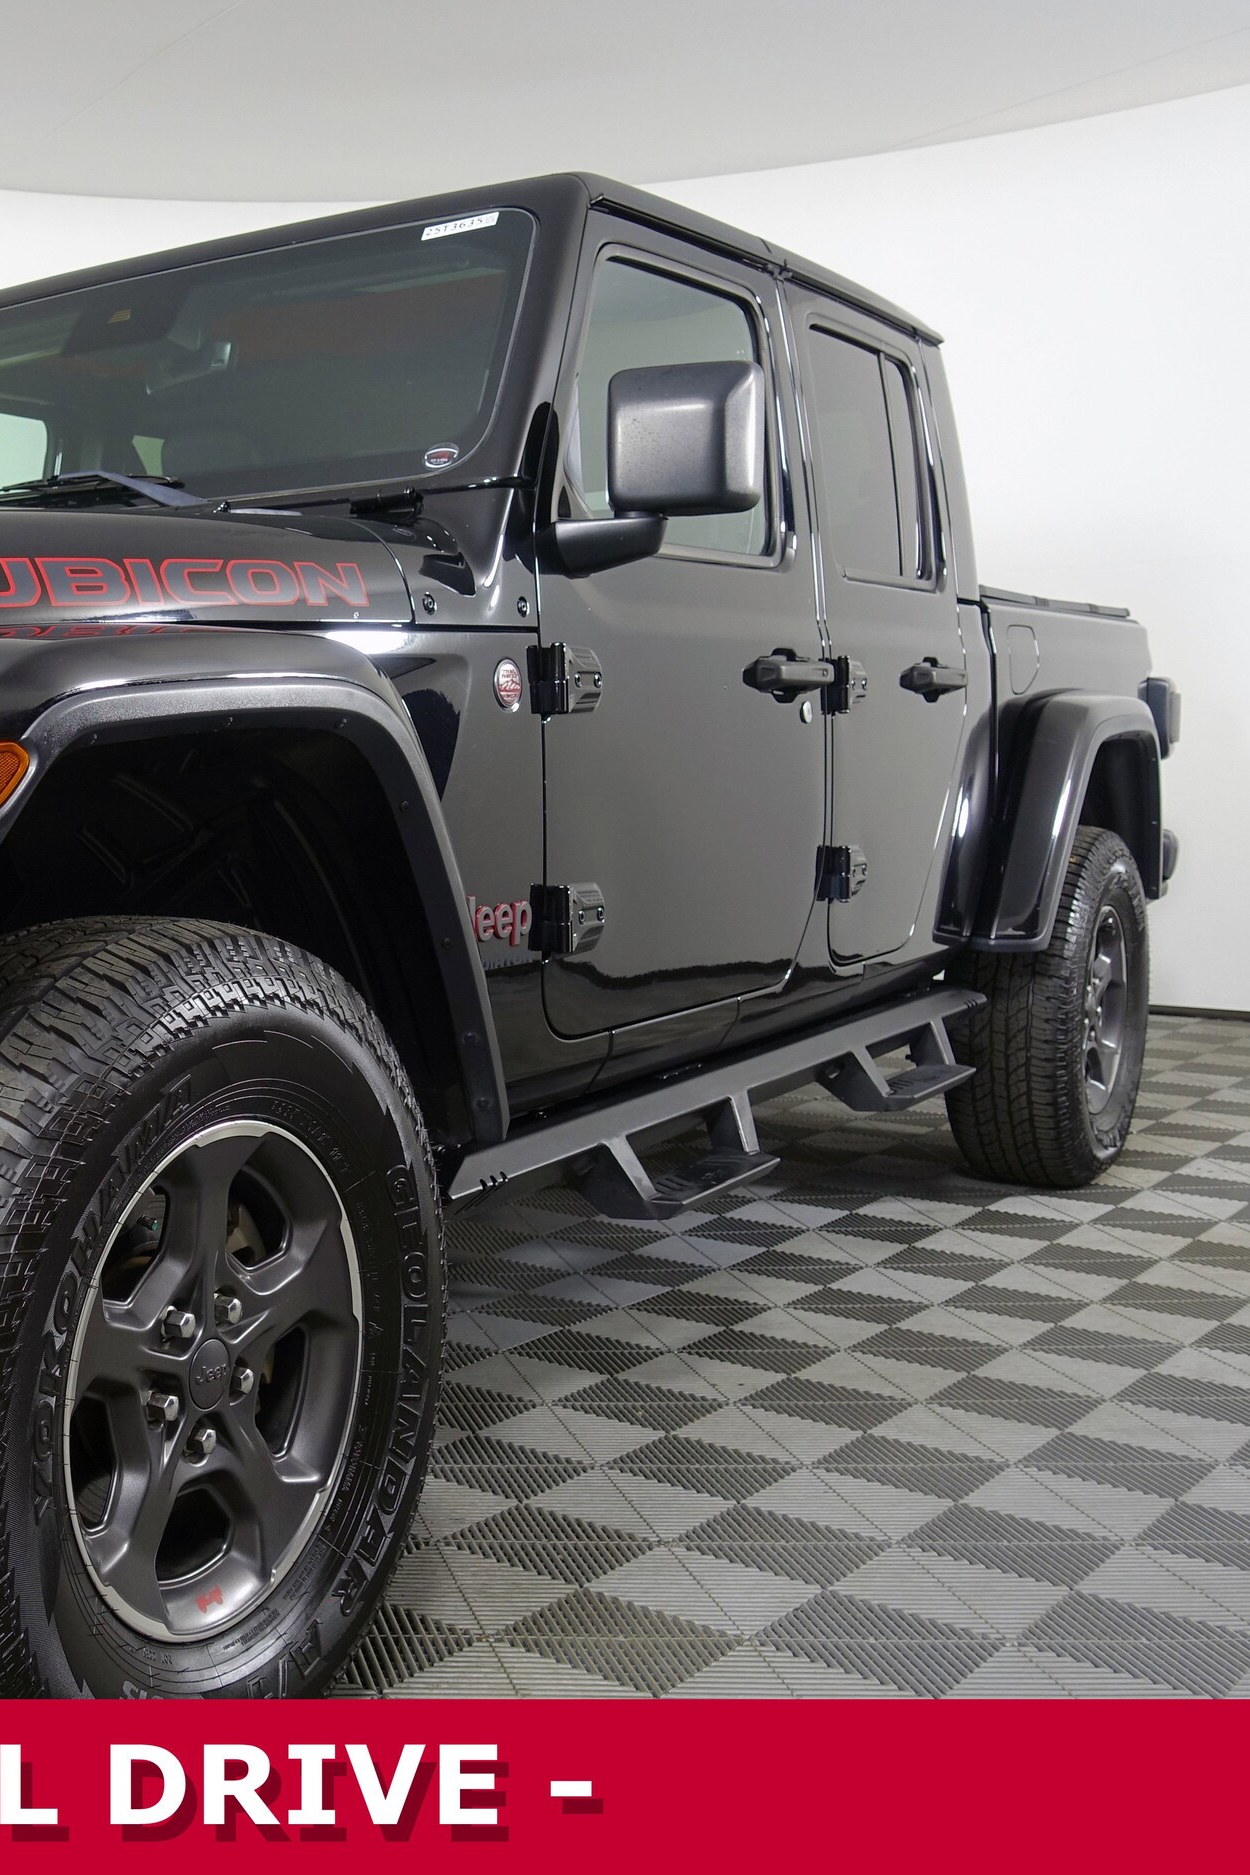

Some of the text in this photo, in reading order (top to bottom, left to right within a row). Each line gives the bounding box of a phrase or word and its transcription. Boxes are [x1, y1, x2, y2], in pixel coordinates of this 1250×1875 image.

[32, 1072, 191, 1526] YOKOHAMA
[195, 1363, 227, 1386] Jeep
[331, 1163, 430, 1617] GEOLANDAR
